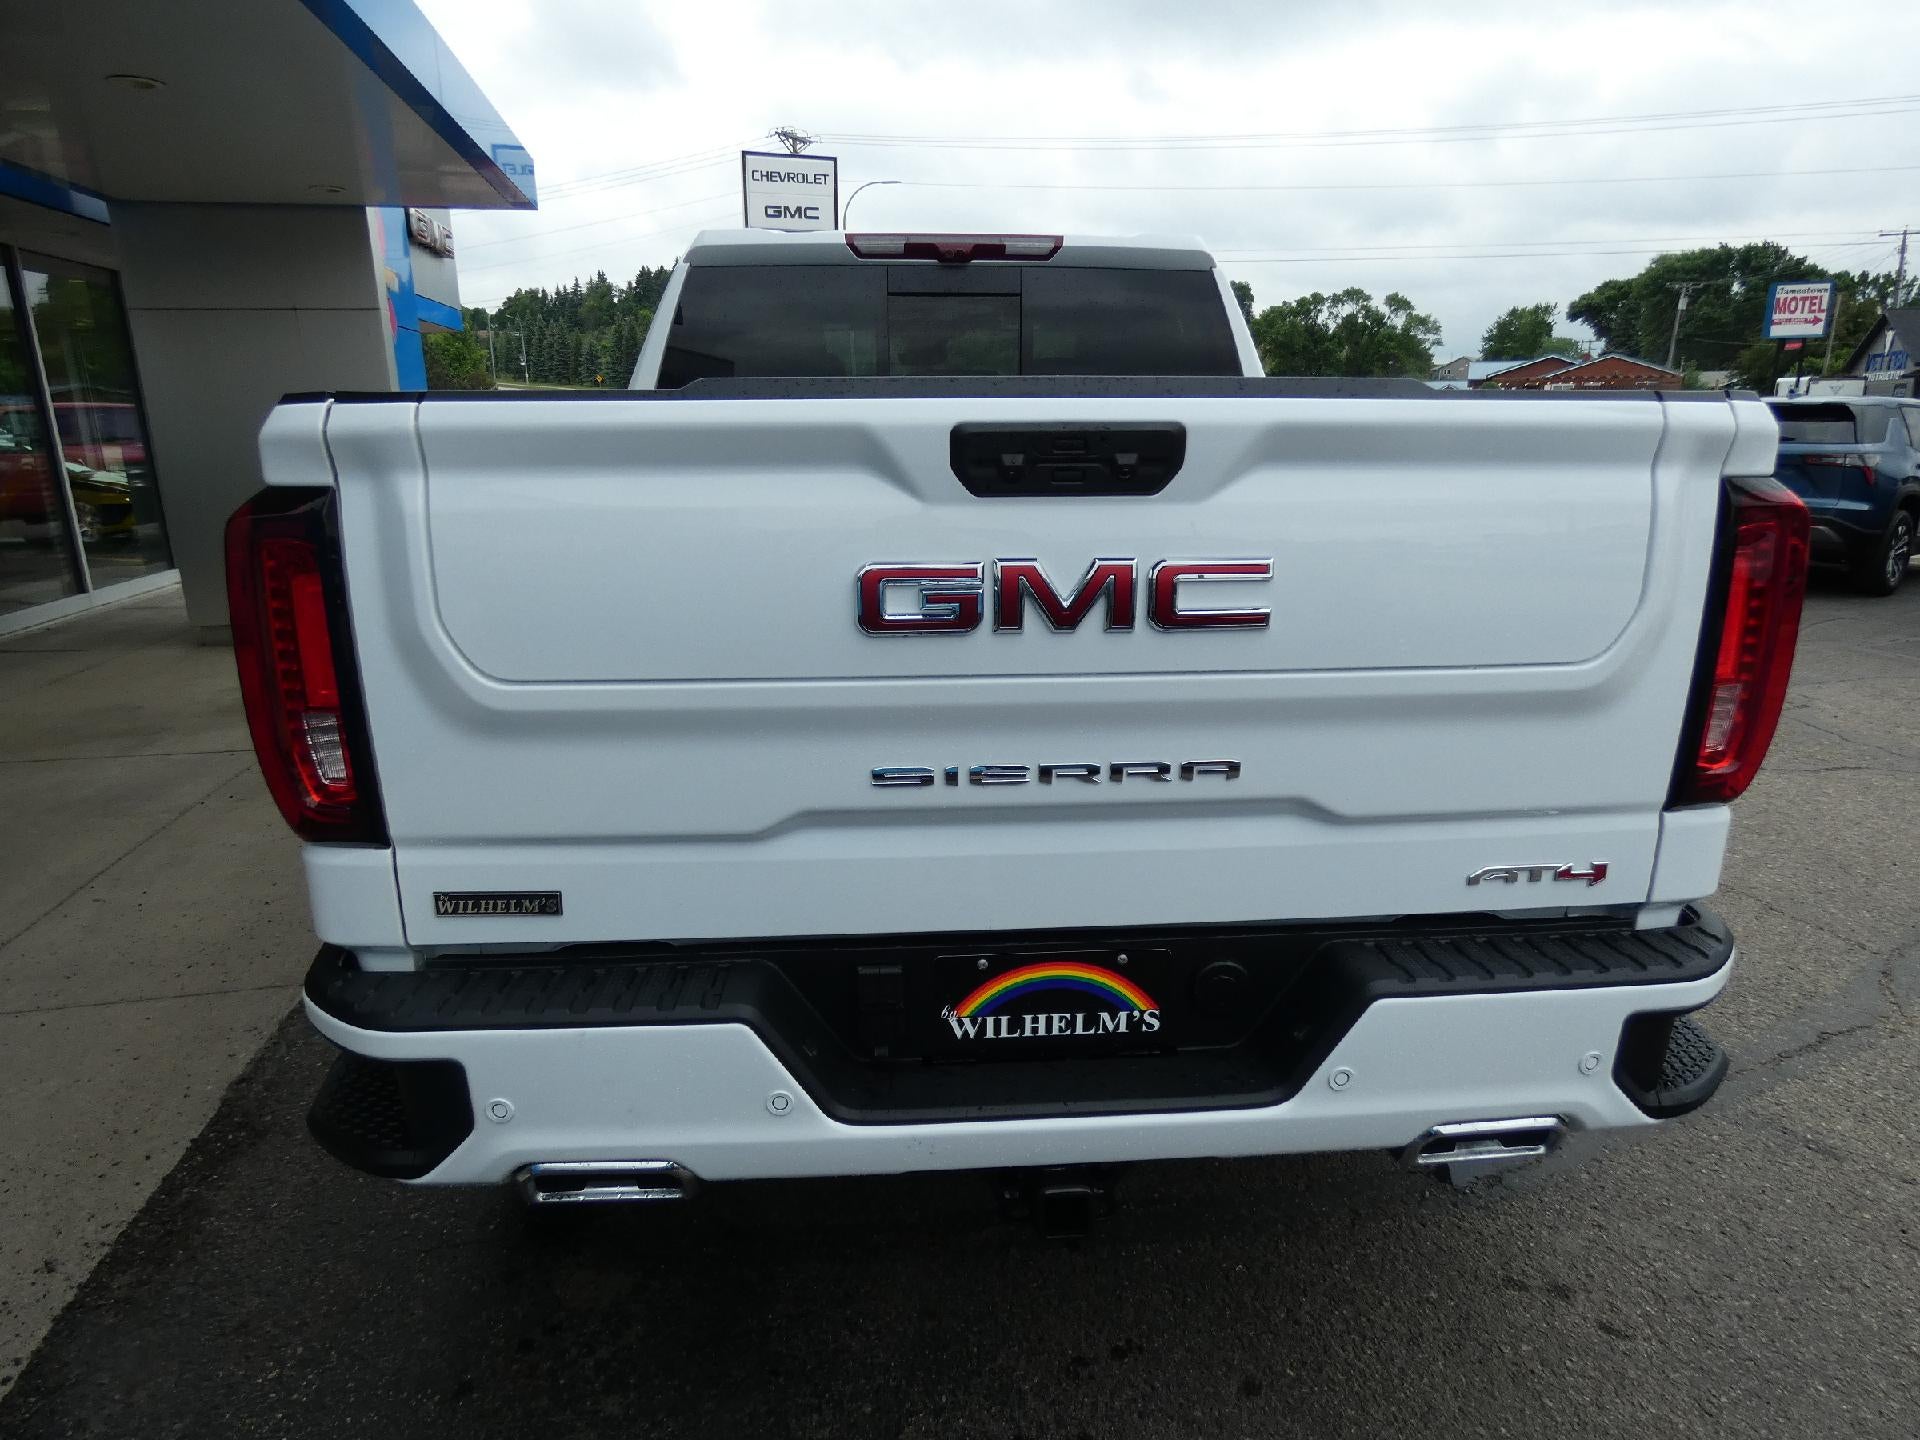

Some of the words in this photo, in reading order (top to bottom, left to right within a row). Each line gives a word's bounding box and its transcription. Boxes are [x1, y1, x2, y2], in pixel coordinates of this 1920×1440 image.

[751, 169, 829, 185] CHEVROLET
[764, 205, 819, 220] GMC
[409, 208, 455, 258] GMC
[1774, 295, 1826, 314] MOTEL
[857, 557, 1274, 636] GMC
[871, 759, 1241, 787] SIERRA
[1466, 861, 1610, 886] AT4
[438, 897, 557, 914] WILHELM'S
[941, 1004, 959, 1022] by
[947, 1009, 1161, 1040] WILHELM'S
